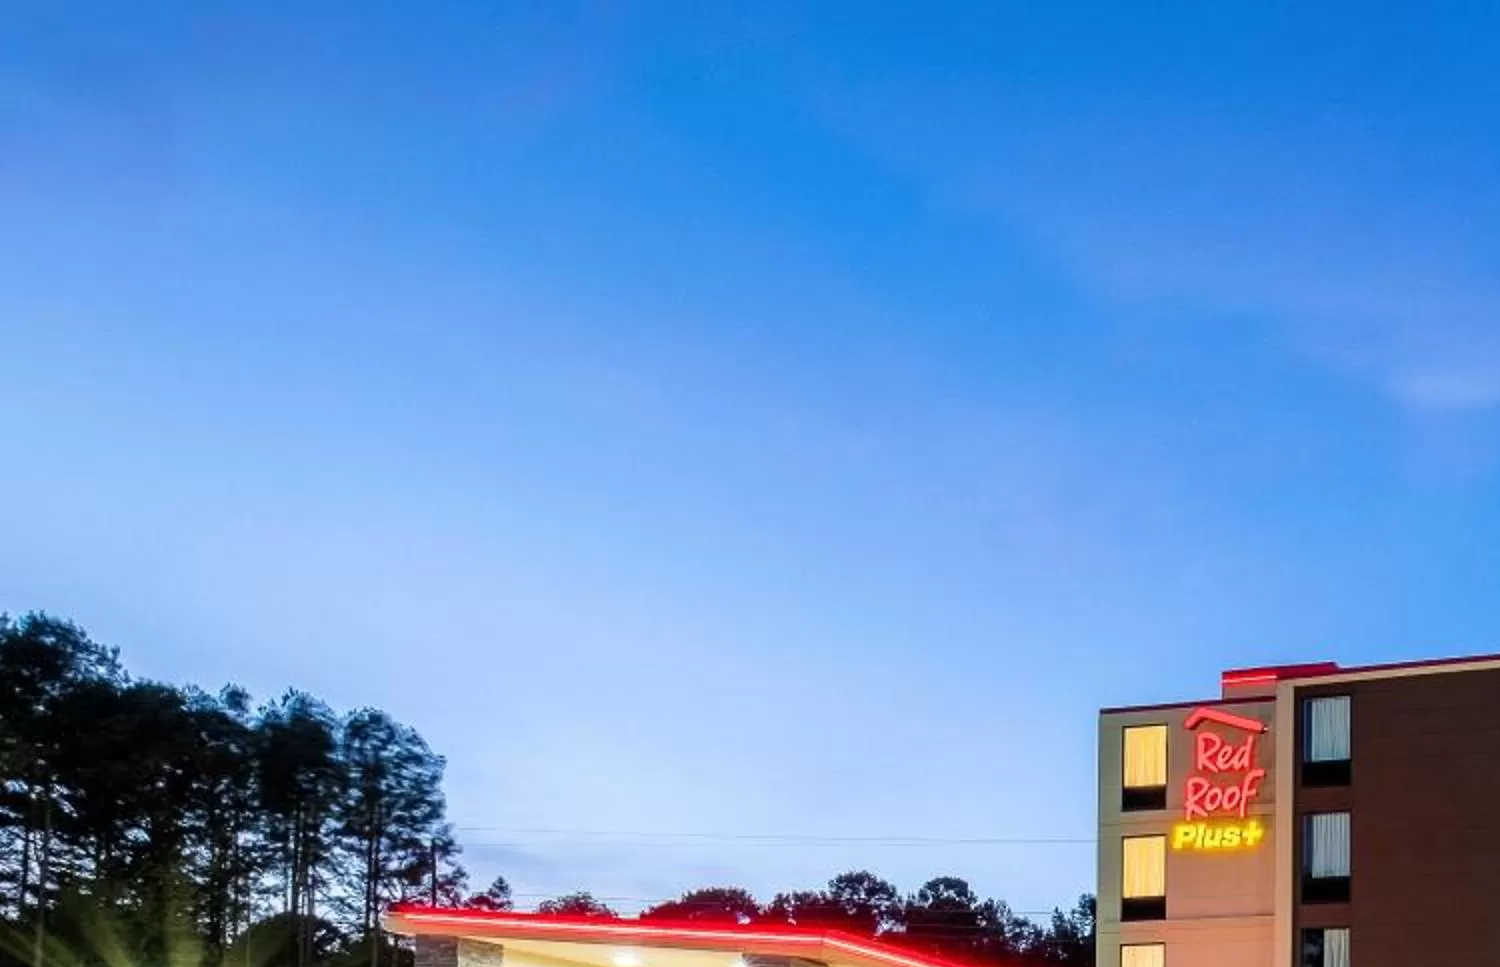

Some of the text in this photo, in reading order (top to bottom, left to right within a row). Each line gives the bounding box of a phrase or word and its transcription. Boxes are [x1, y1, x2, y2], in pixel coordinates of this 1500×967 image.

[1197, 731, 1254, 773] Red
[1184, 768, 1266, 821] Roof
[1172, 820, 1264, 849] Plus+
